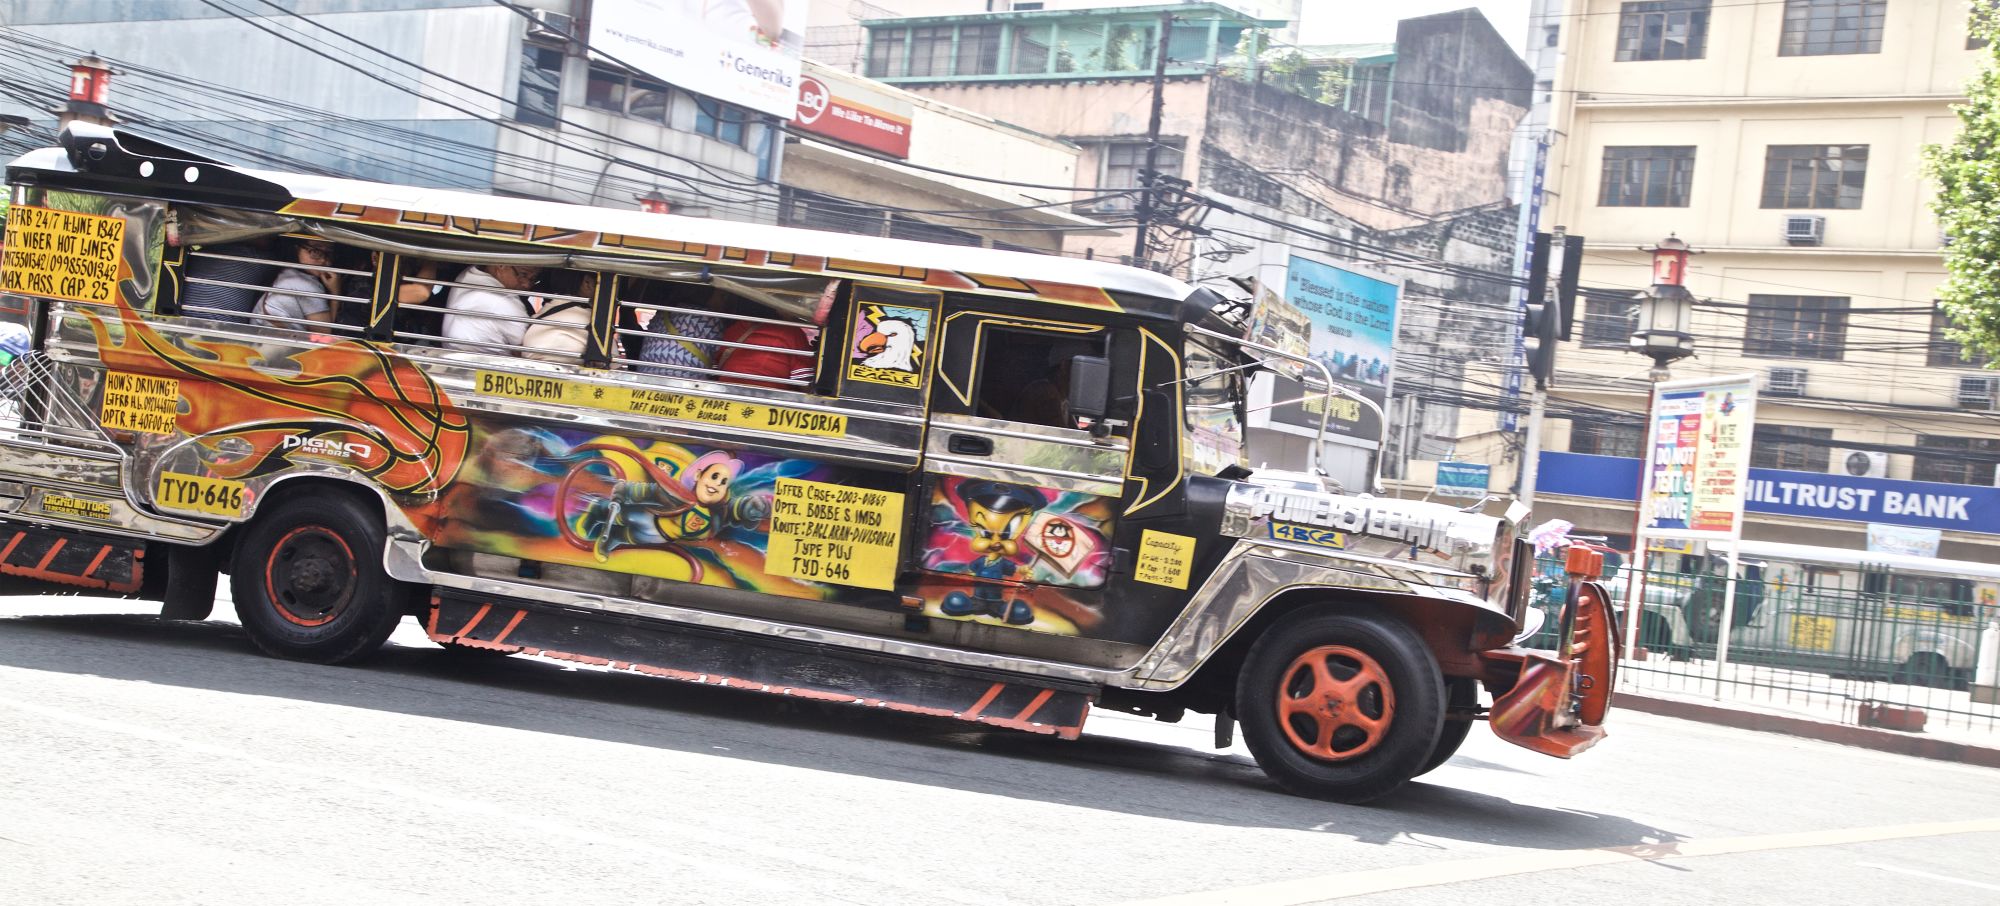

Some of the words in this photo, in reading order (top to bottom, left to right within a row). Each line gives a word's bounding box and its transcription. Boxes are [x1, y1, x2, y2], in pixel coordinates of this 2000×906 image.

[735, 57, 792, 88] Generika
[832, 106, 845, 118] We
[846, 110, 863, 123] Like
[864, 114, 874, 127] To
[874, 119, 895, 132] Move
[8, 208, 33, 227] LTFRB
[36, 211, 60, 229] 24/7
[97, 220, 122, 241] 1342
[6, 230, 18, 248] TXT.
[23, 232, 51, 250] VIBER
[57, 235, 77, 254] HOT
[80, 238, 115, 261] LINES
[1, 270, 25, 290] MAX.
[27, 273, 56, 295] PASS.
[61, 276, 88, 298] CAP.
[92, 281, 109, 300] 25
[1325, 302, 1343, 319] God
[108, 374, 132, 392] HOW'S
[853, 368, 915, 385] EAGLE
[483, 374, 563, 399] BACLARAN
[631, 389, 645, 399] VIA
[106, 393, 129, 407] LTFRB
[629, 401, 648, 412] TAFT
[649, 404, 680, 417] AVENUE
[701, 399, 731, 410] PADRE
[103, 409, 128, 428] OPTR.
[130, 411, 137, 428] #
[697, 410, 727, 421] BURGOS
[768, 408, 841, 432] DIVISORIA
[283, 434, 371, 458] DIGNO
[302, 446, 351, 458] MOTORS
[1655, 447, 1671, 465] DO
[1671, 447, 1696, 465] NOT
[1653, 470, 1683, 493] TEXT
[44, 494, 73, 508] DIGNO
[74, 498, 111, 513] MOTORS
[1745, 480, 1876, 512] HILTRUST
[1883, 491, 1970, 520] BANK
[807, 503, 839, 521] BOBBE
[855, 510, 882, 527] IMBO
[794, 538, 822, 557] TYPE
[828, 543, 853, 560] PUJ
[1146, 537, 1183, 555] Capacity
